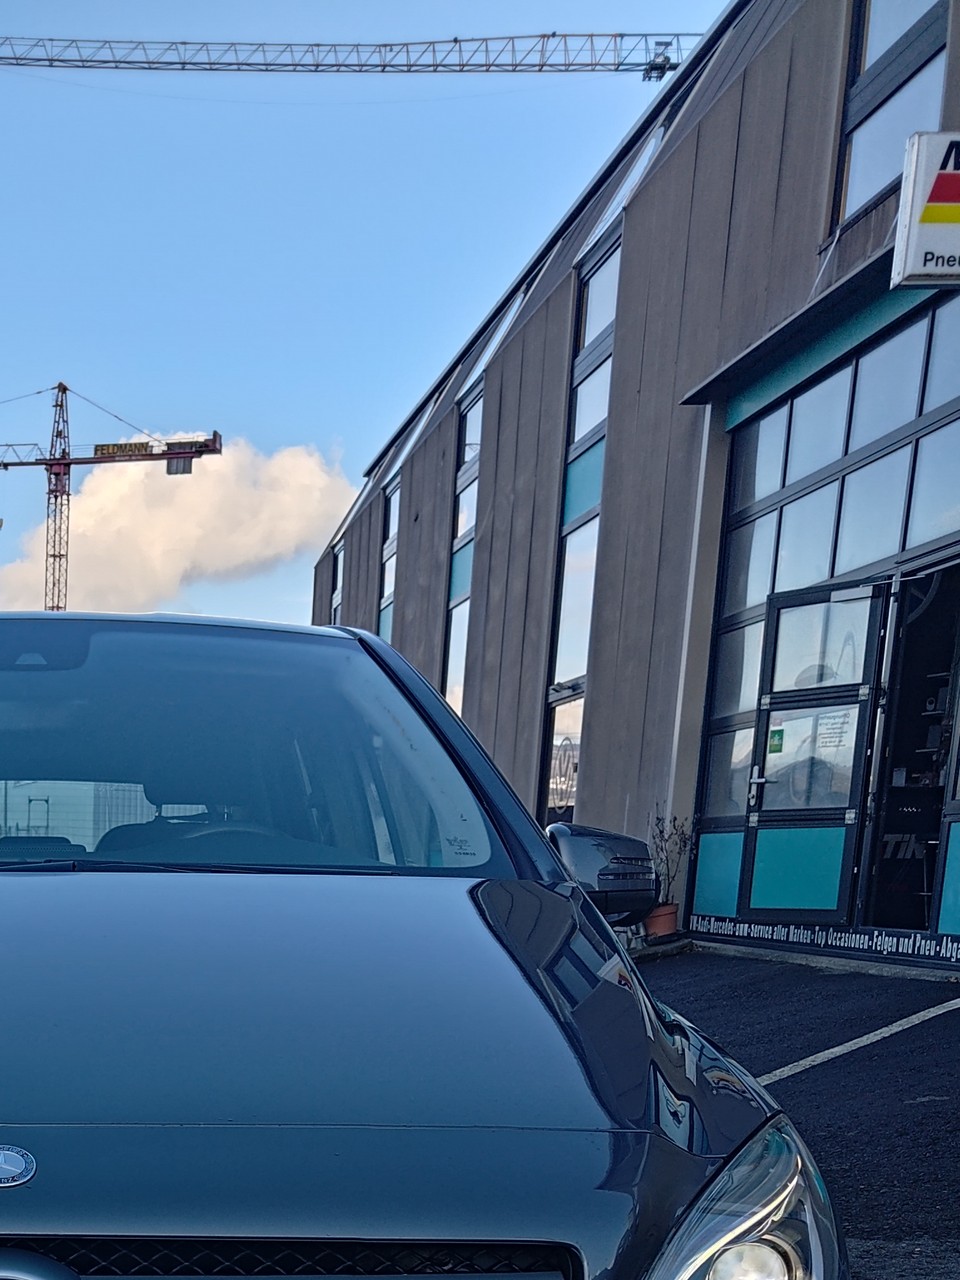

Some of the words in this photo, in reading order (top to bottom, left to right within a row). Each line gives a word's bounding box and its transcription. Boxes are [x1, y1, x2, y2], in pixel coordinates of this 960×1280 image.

[922, 251, 960, 267] Pne
[96, 442, 148, 456] FELDMANN
[898, 933, 915, 954] und
